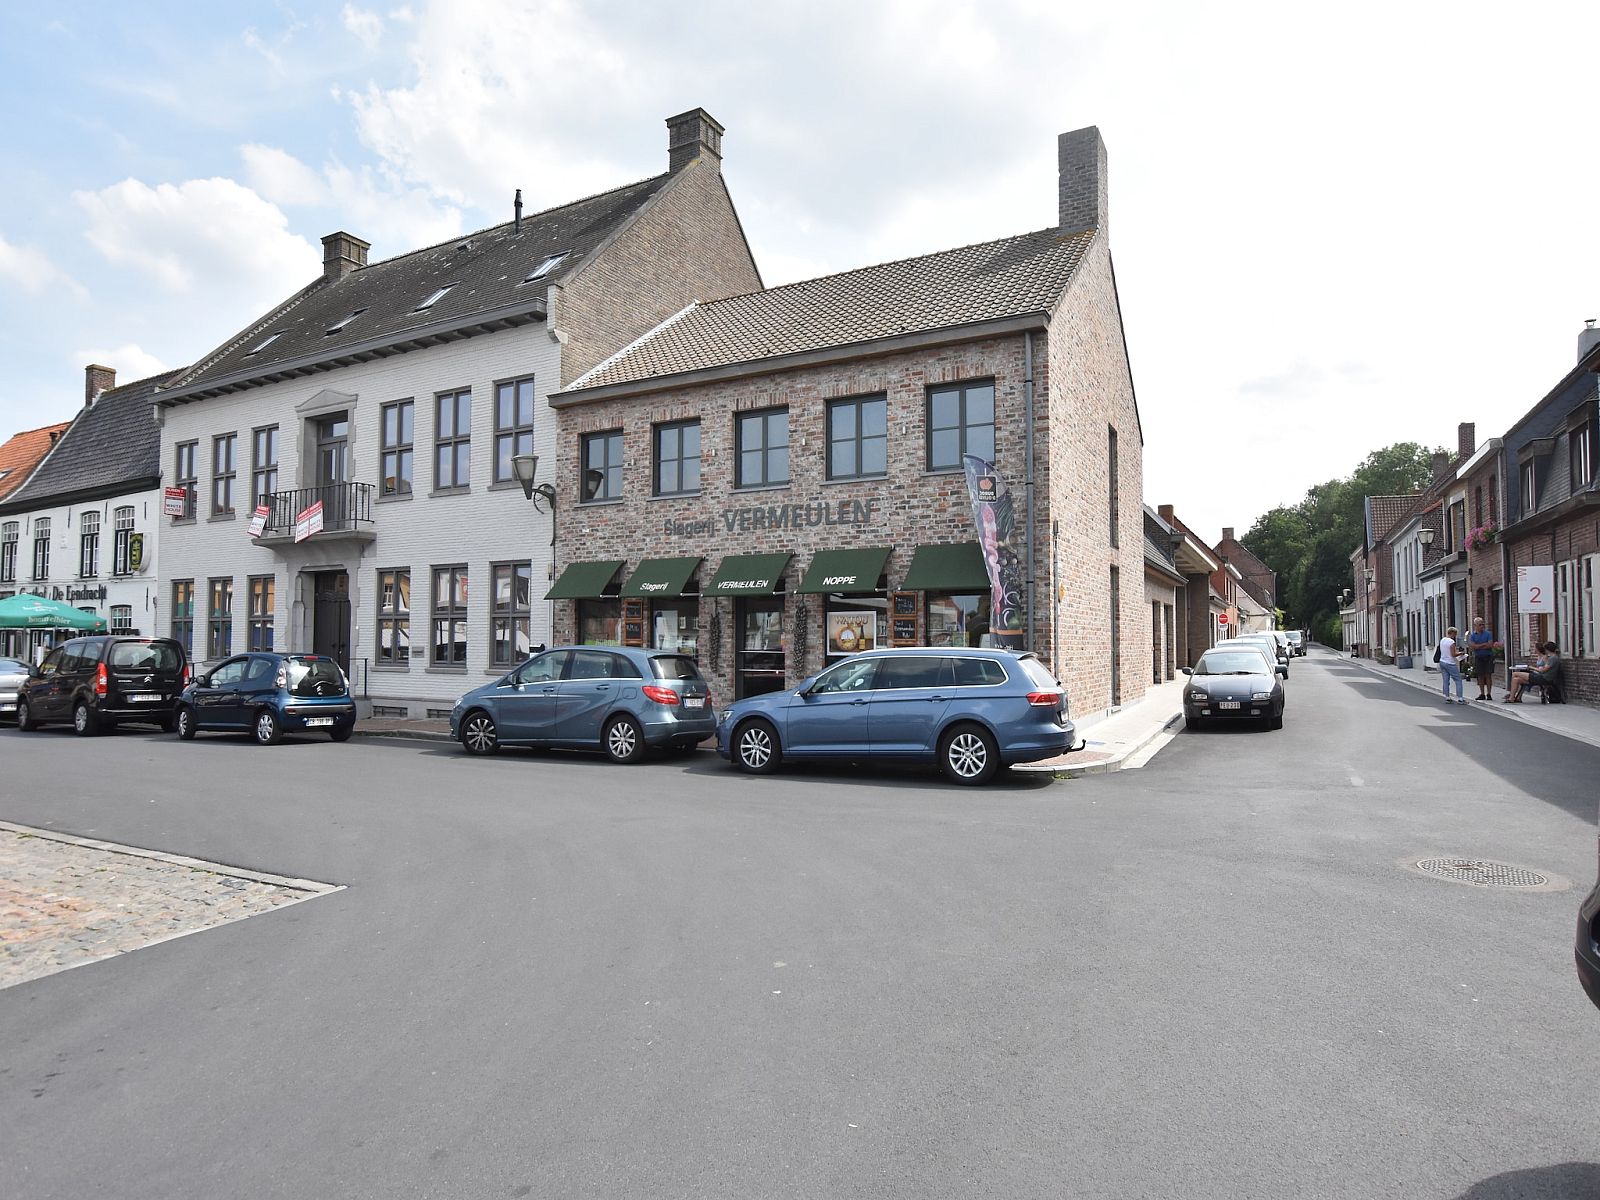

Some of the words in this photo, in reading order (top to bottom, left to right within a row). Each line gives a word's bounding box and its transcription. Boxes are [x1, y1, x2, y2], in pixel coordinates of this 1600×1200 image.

[663, 517, 715, 537] Slagerij
[723, 499, 873, 532] VERMEULEN
[717, 580, 769, 589] VERMEULEN
[822, 576, 857, 586] NOPPE
[639, 582, 669, 592] Slagerij
[52, 586, 64, 601] De
[66, 584, 107, 600] Eendracht
[1529, 586, 1542, 604] 2
[835, 615, 869, 625] WATOU
